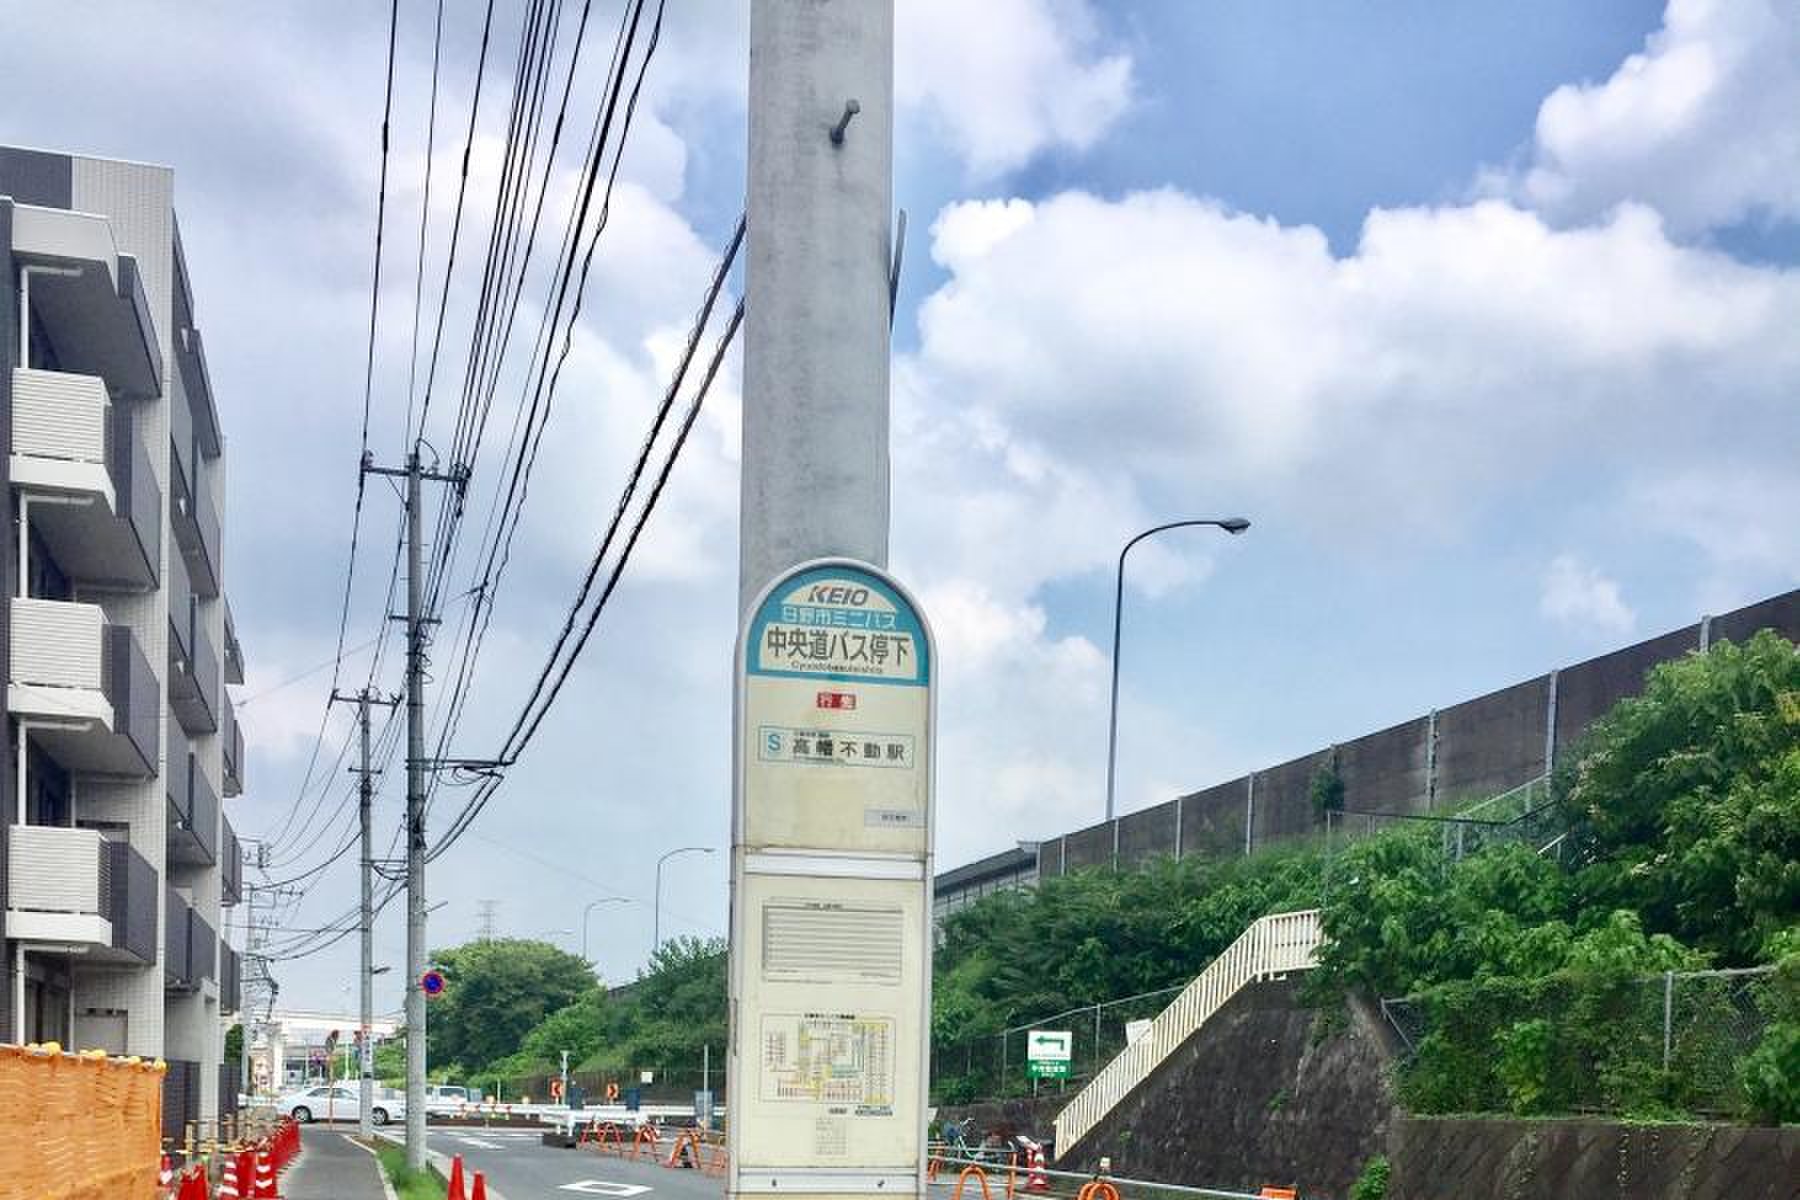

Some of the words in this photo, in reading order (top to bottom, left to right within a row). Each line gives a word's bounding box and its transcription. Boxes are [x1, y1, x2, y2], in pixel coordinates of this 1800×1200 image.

[807, 585, 869, 606] KEIO
[767, 626, 910, 666] 中央道バス停下
[767, 734, 781, 752] S
